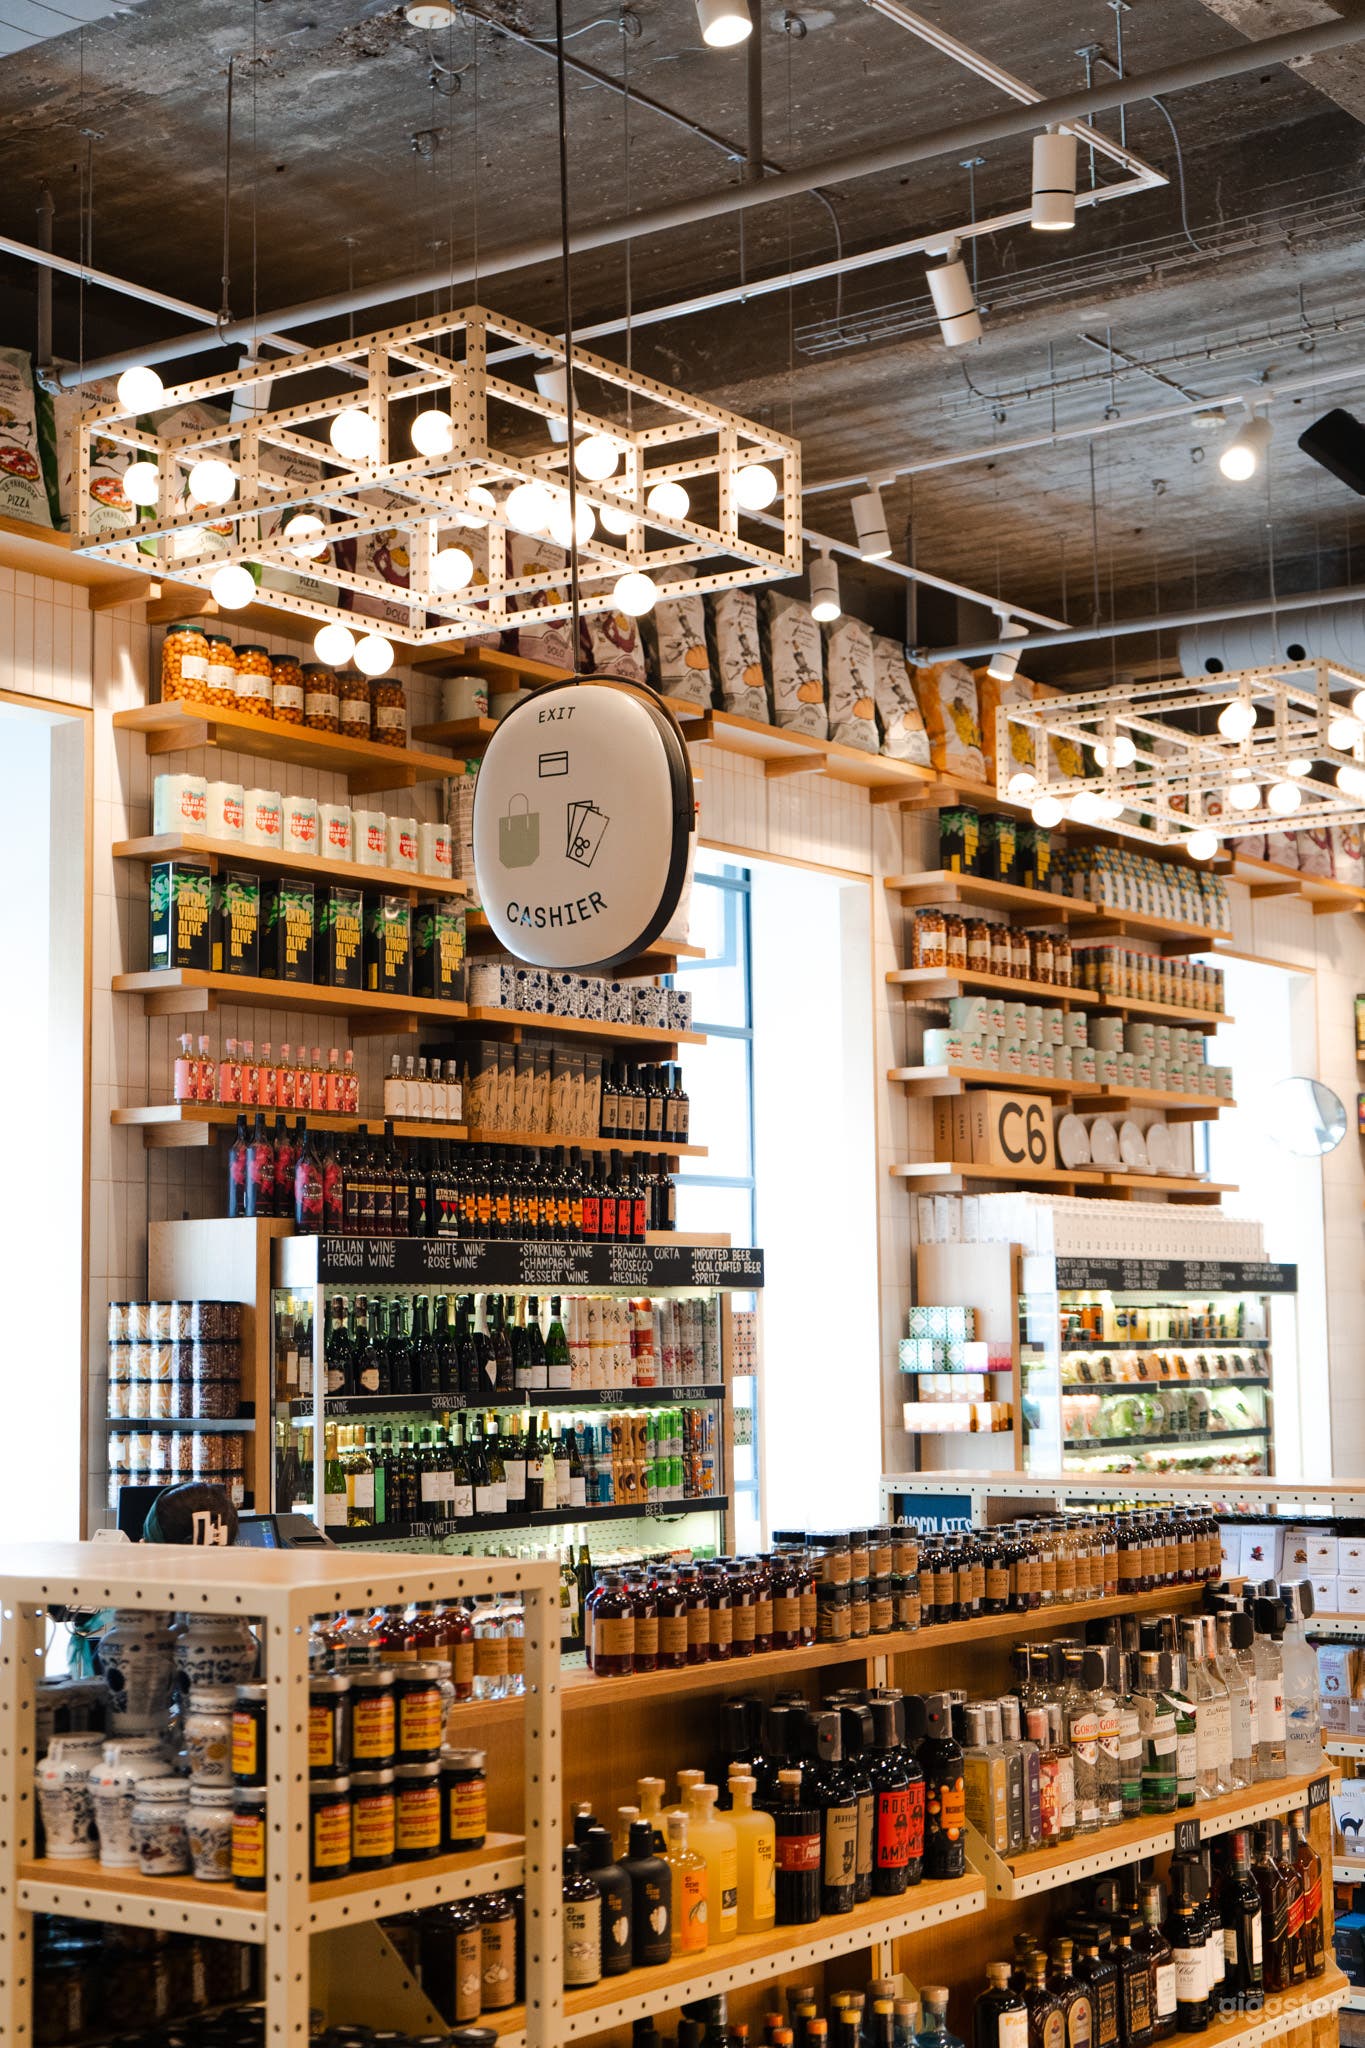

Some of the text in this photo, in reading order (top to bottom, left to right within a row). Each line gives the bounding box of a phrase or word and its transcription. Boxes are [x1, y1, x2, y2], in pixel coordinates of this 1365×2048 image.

[8, 494, 30, 510] PIZZA
[538, 706, 576, 723] EXIT
[178, 891, 206, 908] EXTRA
[178, 906, 208, 922] VIRGIN
[231, 900, 255, 916] EXTRA
[506, 891, 608, 928] CASHIER
[232, 915, 256, 931] VIRGIN
[286, 908, 310, 924] EXTRA
[336, 915, 358, 930] EXTRA
[178, 921, 202, 936] OLIVE
[286, 922, 312, 938] VIRGIN
[178, 936, 192, 950] OIL
[231, 929, 252, 944] OLIVE
[286, 936, 307, 951] OLIVE
[336, 929, 360, 944] VIRGIN
[231, 943, 243, 957] OIL
[286, 950, 298, 964] OIL
[336, 942, 356, 958] OLIVE
[336, 956, 347, 970] OIL
[998, 1102, 1047, 1164] C6
[326, 1240, 396, 1254] ITALIAN WINE
[427, 1242, 486, 1256] WHITE WINE
[523, 1246, 594, 1258] SPARKLING WINE
[612, 1246, 680, 1260] FRANCIA CORTA
[328, 1254, 395, 1268] FRENCH WINE
[453, 1256, 478, 1268] WINE
[694, 1249, 750, 1262] IMPORTED BEER
[524, 1258, 575, 1270] CHAMPAGNE
[612, 1260, 654, 1272] PROSECCO
[694, 1260, 762, 1274] LOCAL CRAFTED BEER
[525, 1270, 590, 1283] DESSERT WINE
[613, 1272, 648, 1285] RIESLING
[696, 1273, 720, 1285] SPRITZ
[431, 1394, 466, 1409] SPARKLING
[600, 1390, 624, 1402] SPRITZ
[672, 1389, 708, 1400] NON-ALCOHOL
[332, 1400, 349, 1414] WINE
[645, 1503, 664, 1516] BEER
[410, 1520, 457, 1536] ITALY WHITE
[1310, 1783, 1328, 1805] VODKA
[1180, 1823, 1196, 1850] GIN
